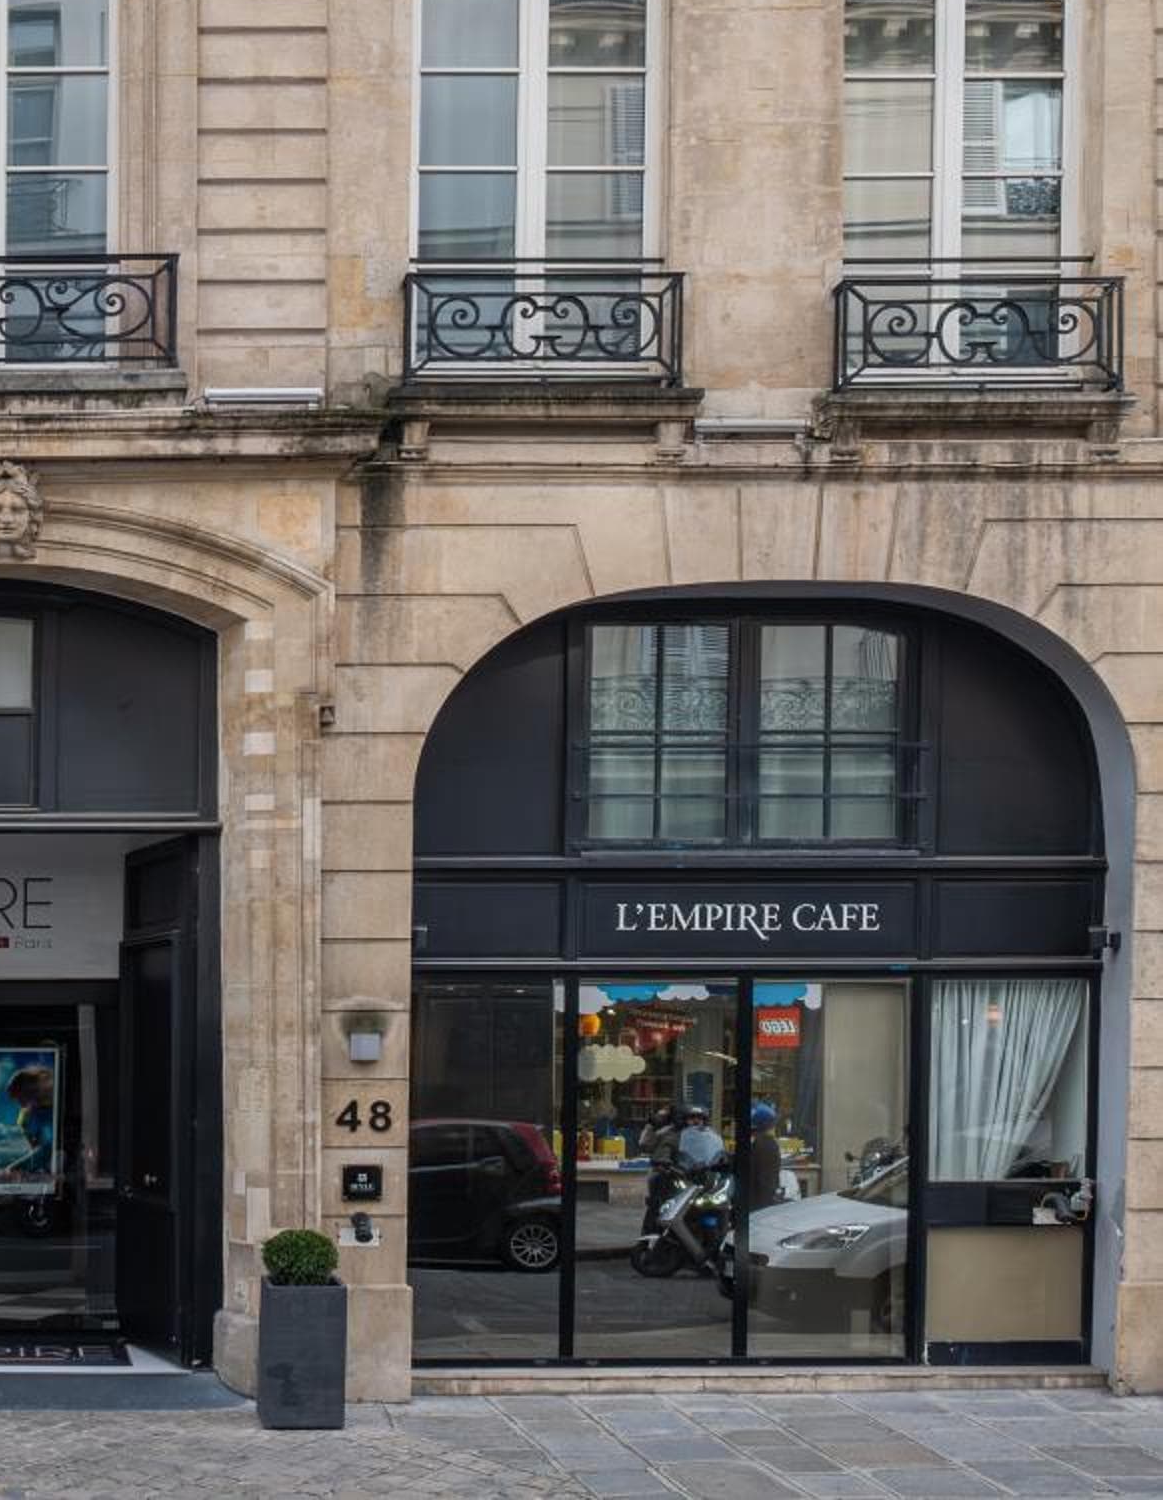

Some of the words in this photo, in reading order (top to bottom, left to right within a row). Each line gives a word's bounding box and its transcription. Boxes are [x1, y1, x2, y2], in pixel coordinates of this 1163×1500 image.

[616, 903, 782, 941] L'EMPIRE
[792, 903, 880, 931] CAFE
[336, 1099, 392, 1133] 48
